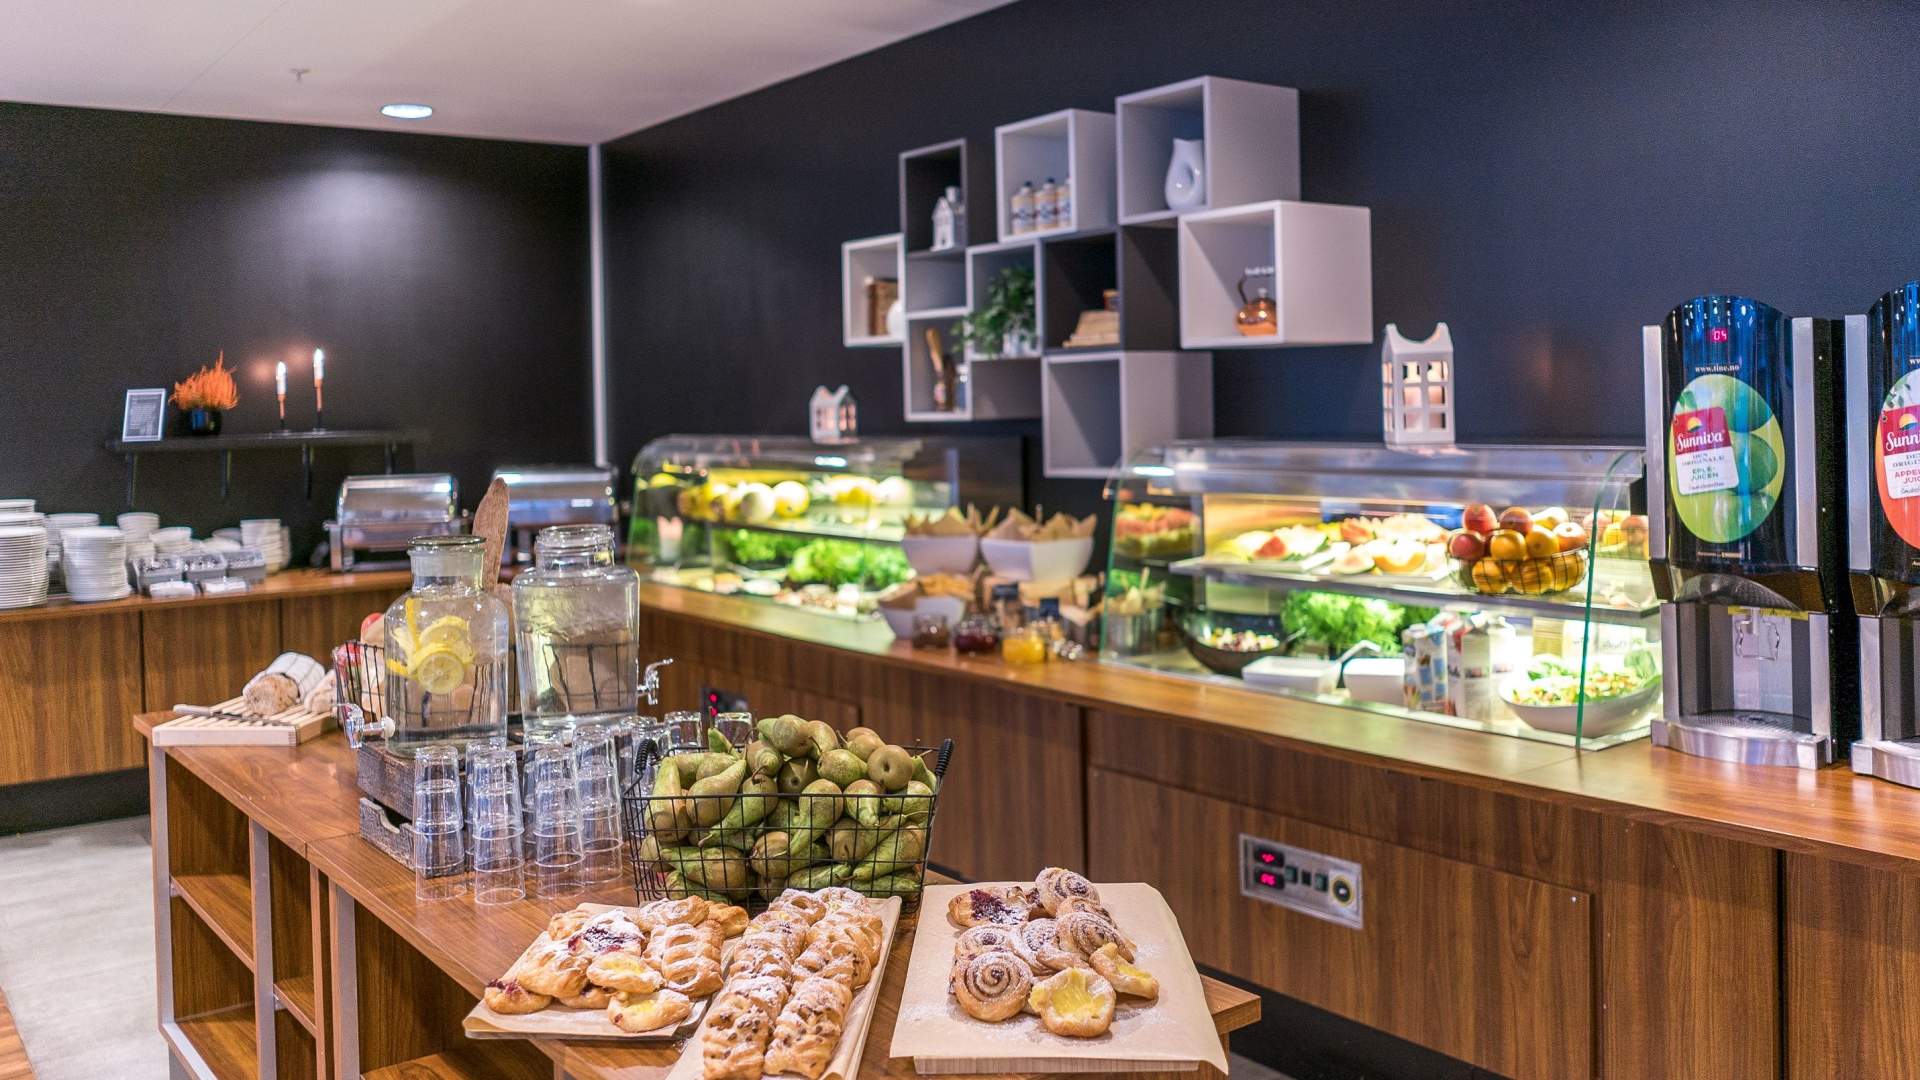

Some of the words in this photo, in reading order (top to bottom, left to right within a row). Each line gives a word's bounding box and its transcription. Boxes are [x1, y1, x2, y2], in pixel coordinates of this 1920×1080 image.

[1695, 363, 1740, 372] www.tine.no
[1677, 431, 1724, 452] Sunniva
[1885, 431, 1920, 451] Sunn
